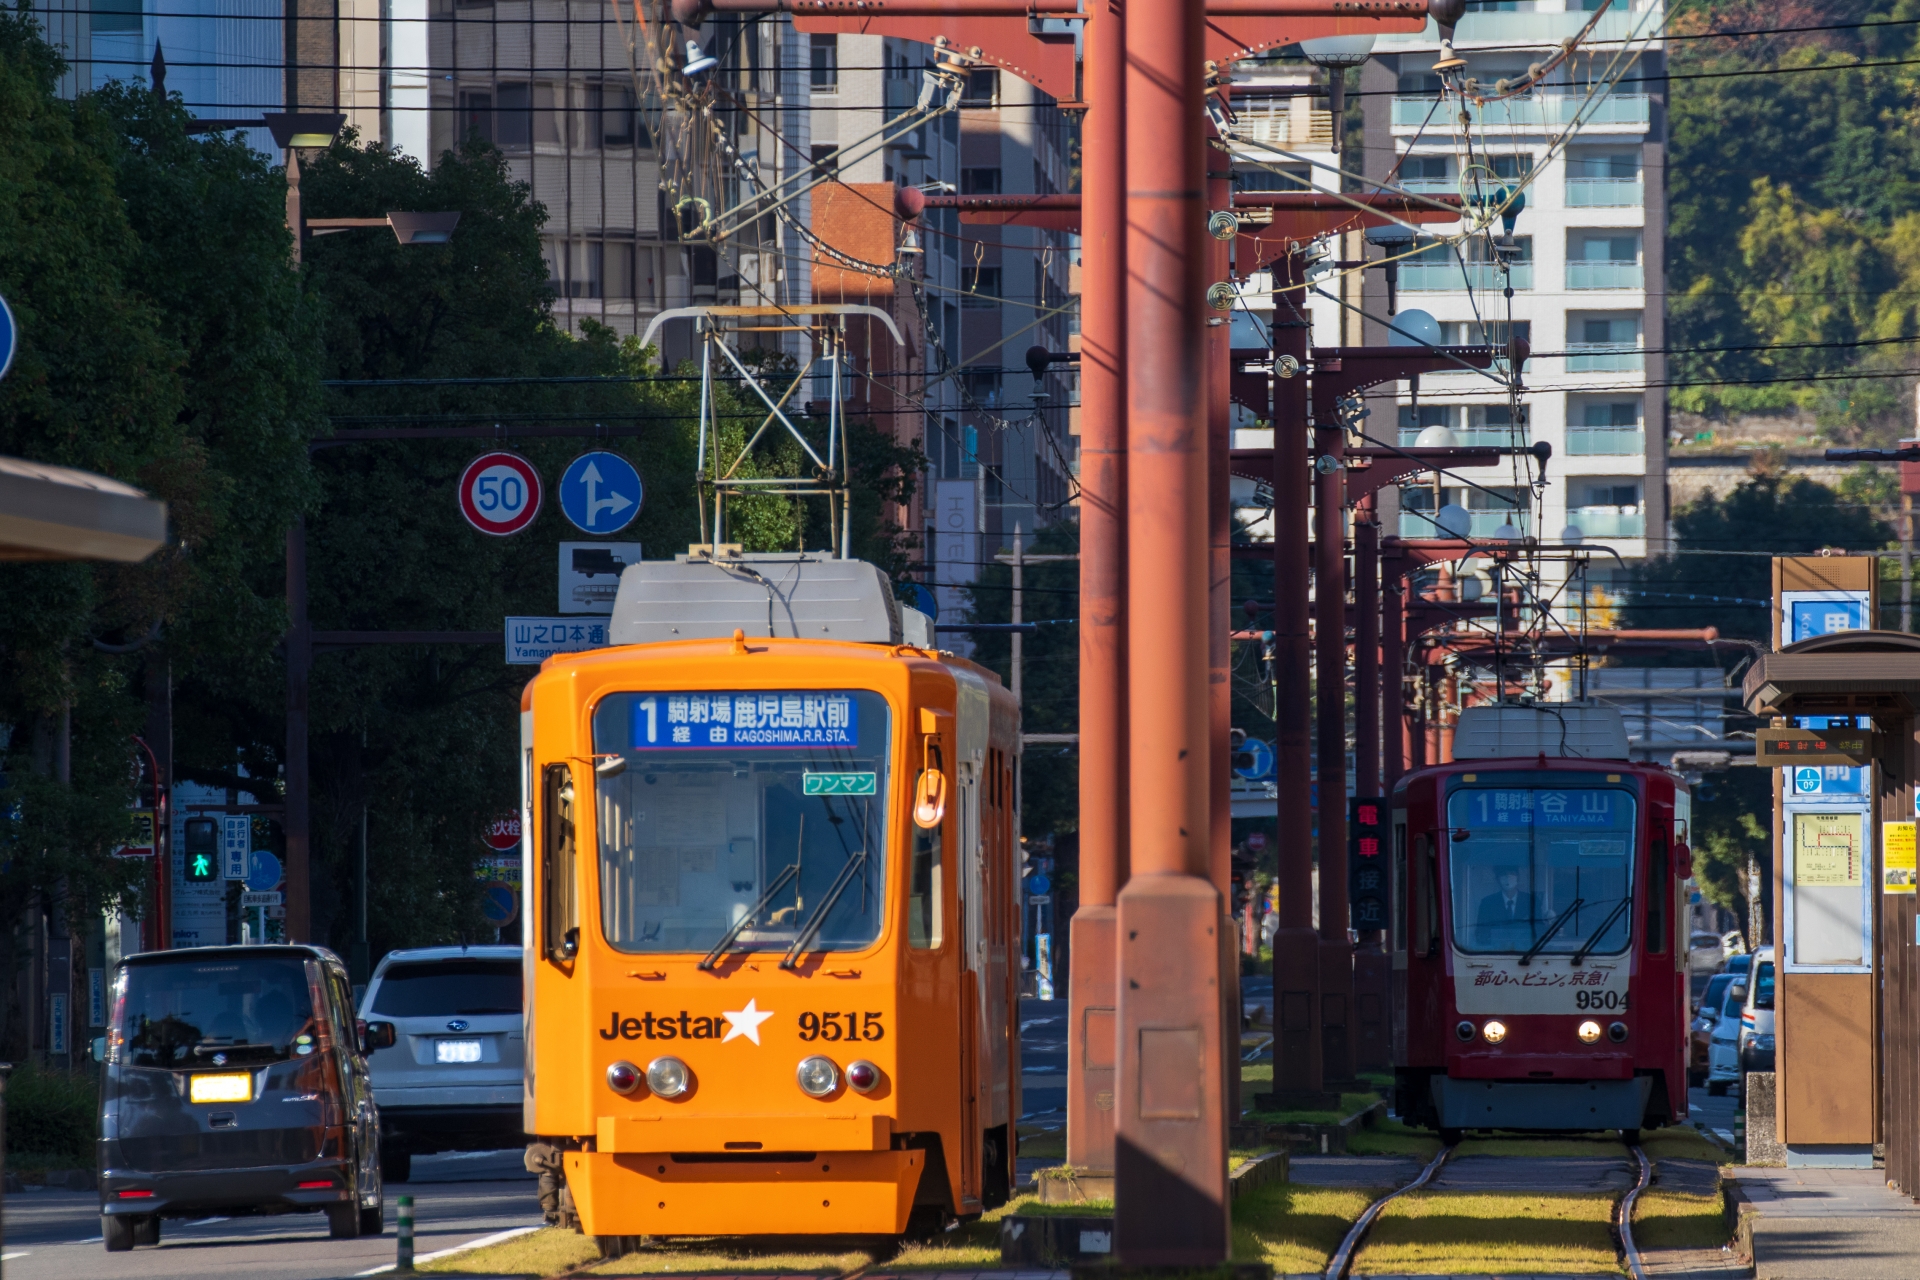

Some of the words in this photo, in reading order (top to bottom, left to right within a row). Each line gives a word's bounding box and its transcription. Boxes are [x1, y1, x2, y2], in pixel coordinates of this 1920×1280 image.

[478, 476, 522, 511] 50
[947, 496, 965, 571] HOTEL
[514, 624, 604, 644] 山之口本通
[639, 696, 657, 743] 1
[667, 695, 732, 724] 騎射場
[733, 693, 850, 729] 鹿児島駅前
[672, 725, 728, 743] 経由
[733, 729, 850, 743] KAGOSHIMA.R.R.STA.
[806, 776, 873, 793] ワンマン
[1803, 780, 1814, 789] 09
[1477, 792, 1488, 823] 1
[1540, 792, 1609, 814] 谷山
[1545, 814, 1605, 823] TANIYAMA
[226, 820, 236, 849] 自転車
[236, 820, 246, 849] 歩行者
[230, 851, 242, 875] 専用
[1357, 805, 1380, 923] 電車接近
[1575, 989, 1632, 1011] 9504
[599, 1010, 727, 1040] Jetstar
[798, 1011, 884, 1042] 9515
